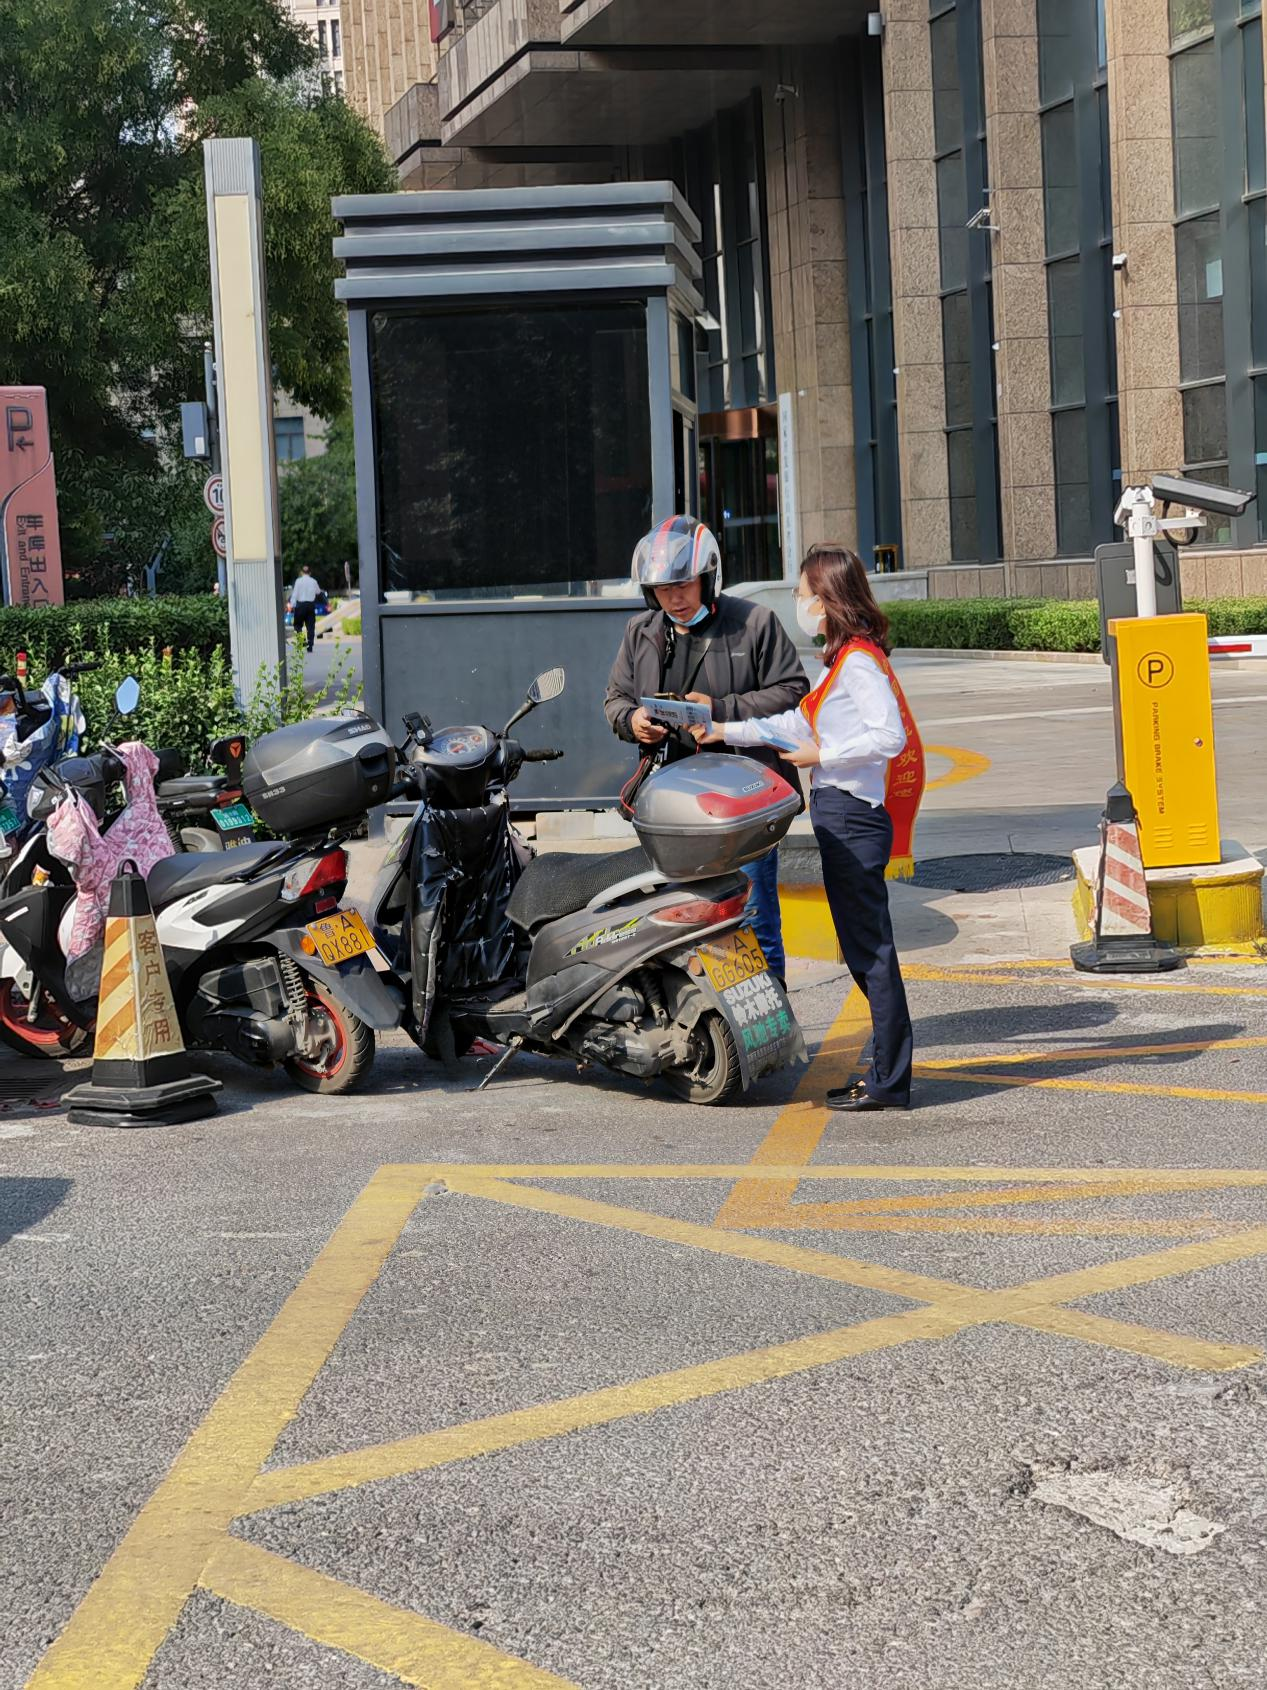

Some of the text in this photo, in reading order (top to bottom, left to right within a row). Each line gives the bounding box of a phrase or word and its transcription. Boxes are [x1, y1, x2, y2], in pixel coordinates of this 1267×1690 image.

[16, 514, 26, 536] Exit
[18, 540, 28, 561] and
[1147, 659, 1164, 684] P
[1152, 701, 1166, 815] PARKING BRAKE SYSTEM
[321, 928, 370, 961] QX881
[711, 948, 764, 988] GG605
[722, 971, 773, 1006] SUZUKI
